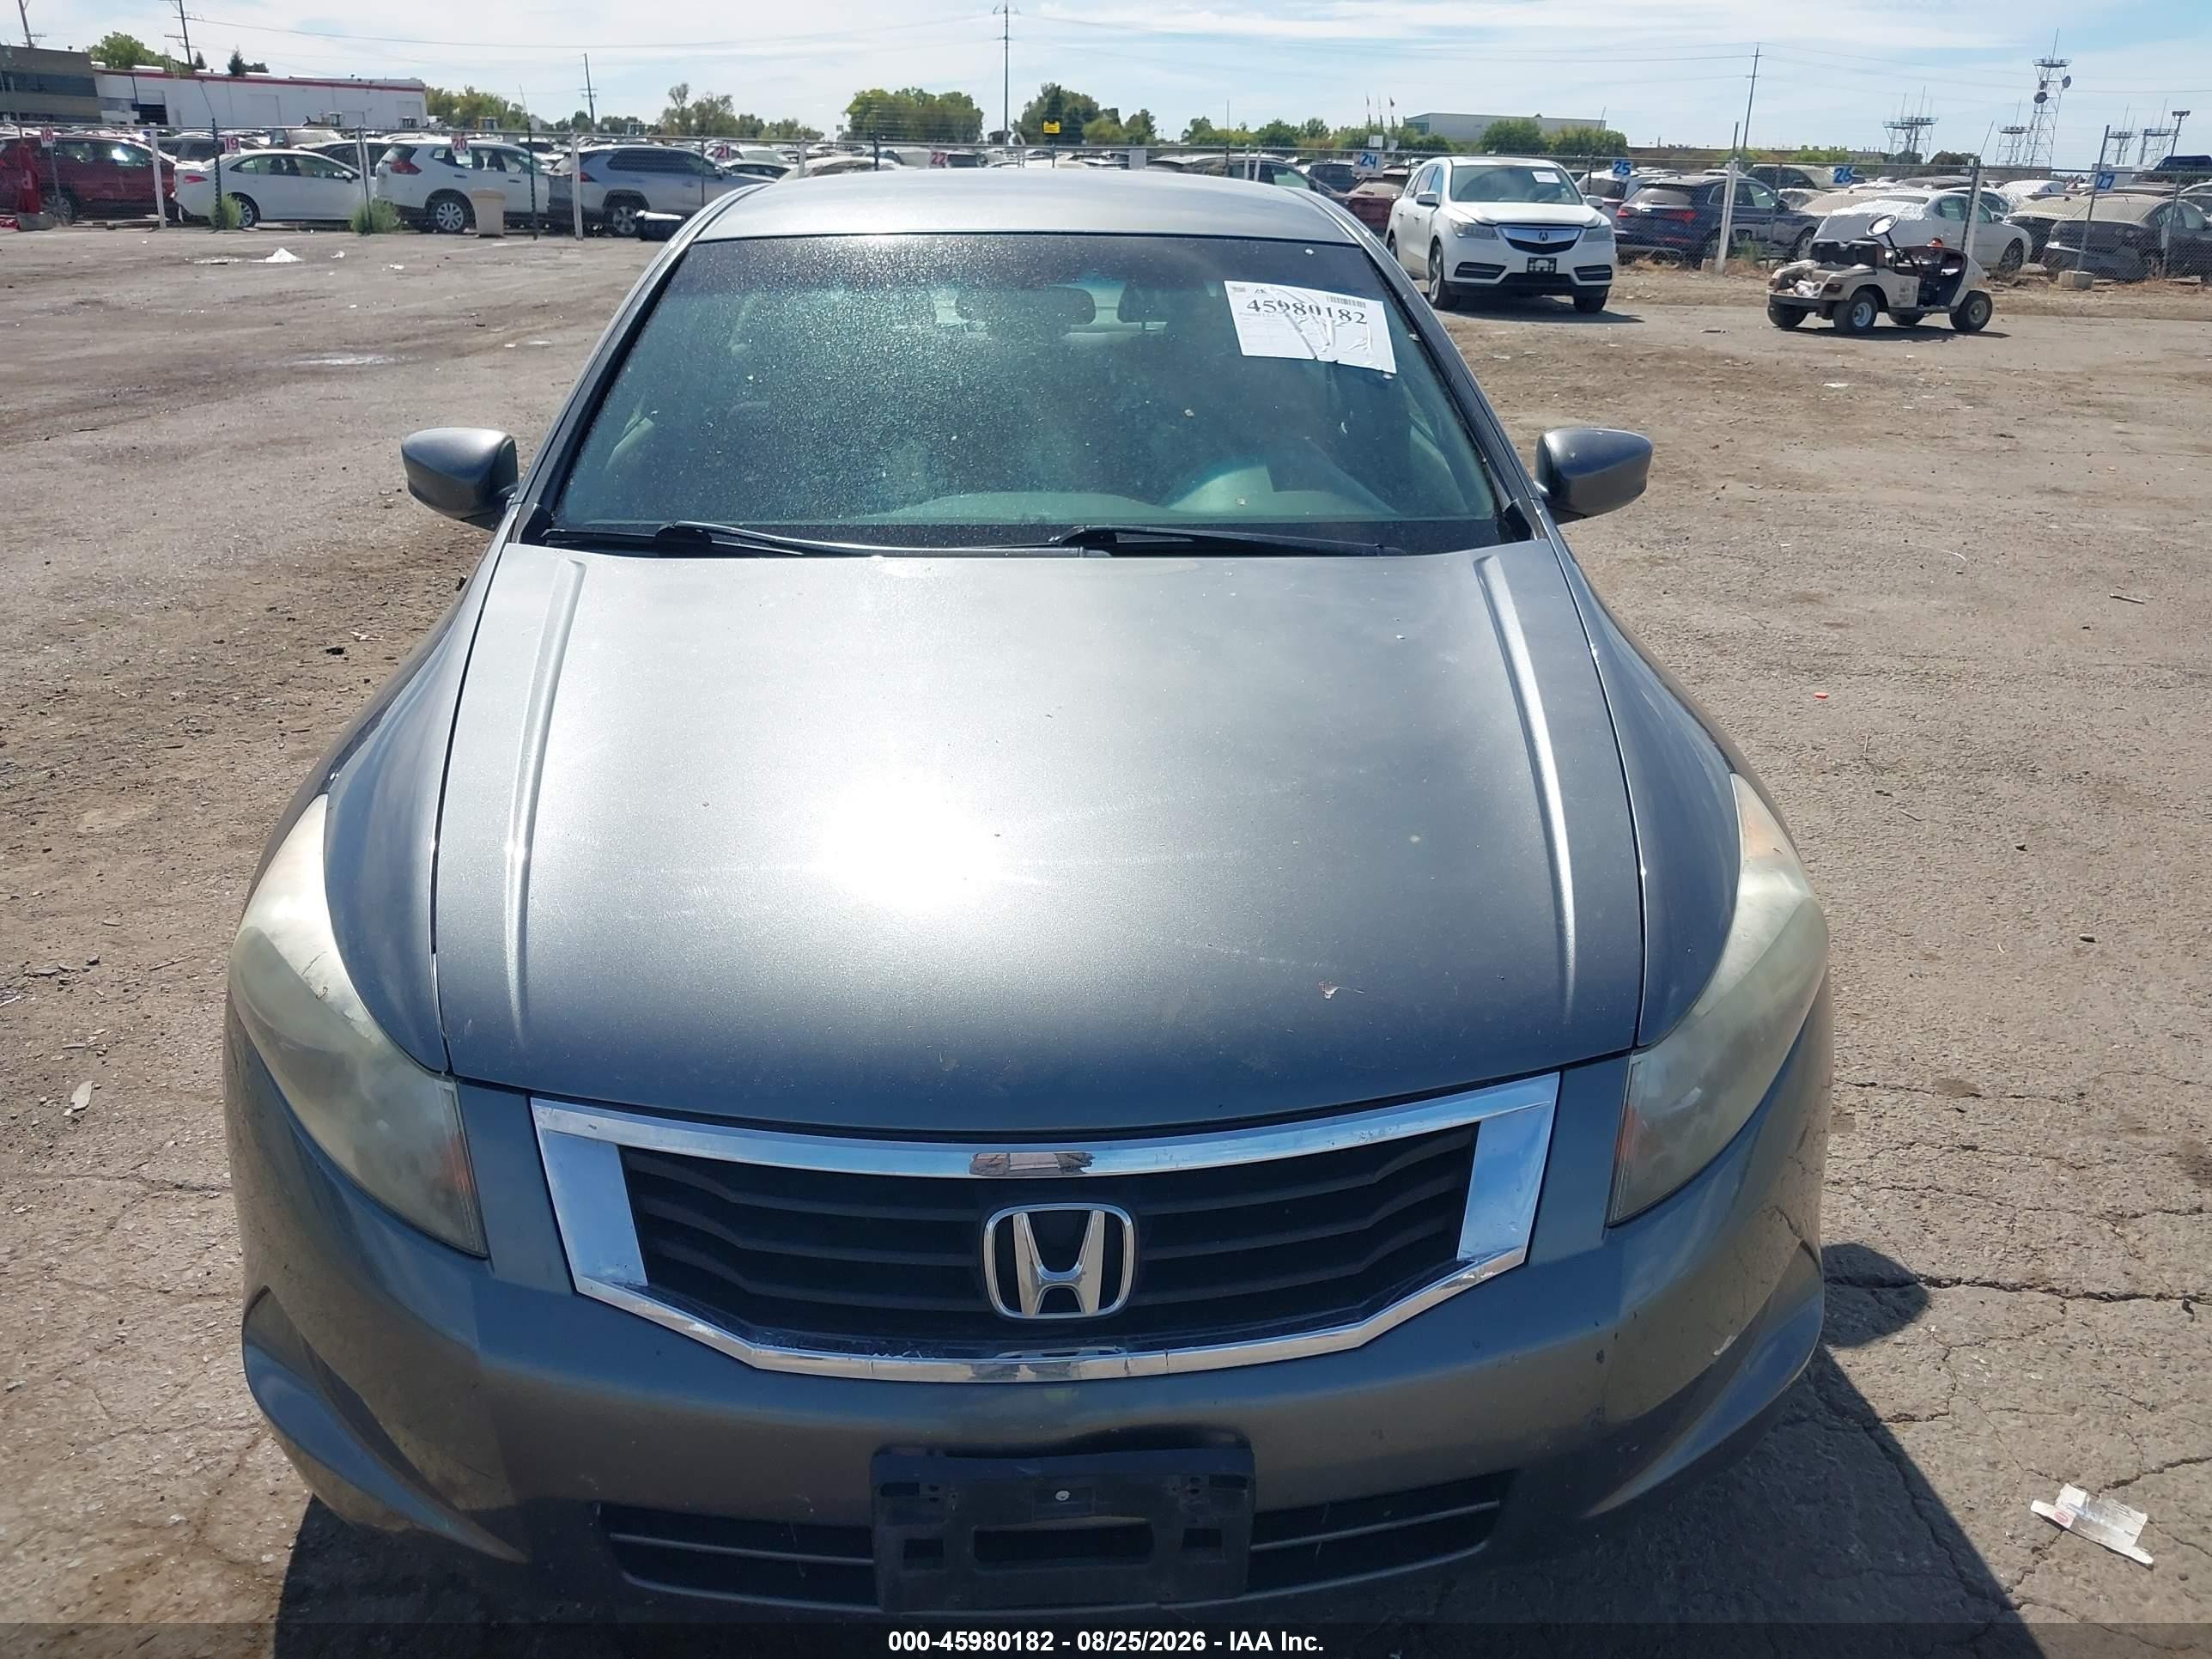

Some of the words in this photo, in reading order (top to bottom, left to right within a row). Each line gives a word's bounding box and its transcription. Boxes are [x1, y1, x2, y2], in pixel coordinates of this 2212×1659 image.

[41, 129, 53, 143] 18
[226, 137, 240, 150] 19
[453, 138, 467, 151] 20
[715, 146, 730, 159] 21
[931, 152, 946, 165] 22
[1360, 152, 1377, 169] 24
[1613, 161, 1631, 175] 25
[1833, 167, 1852, 183] 26
[2097, 173, 2115, 190] 27
[1247, 299, 1367, 325] 45980182
